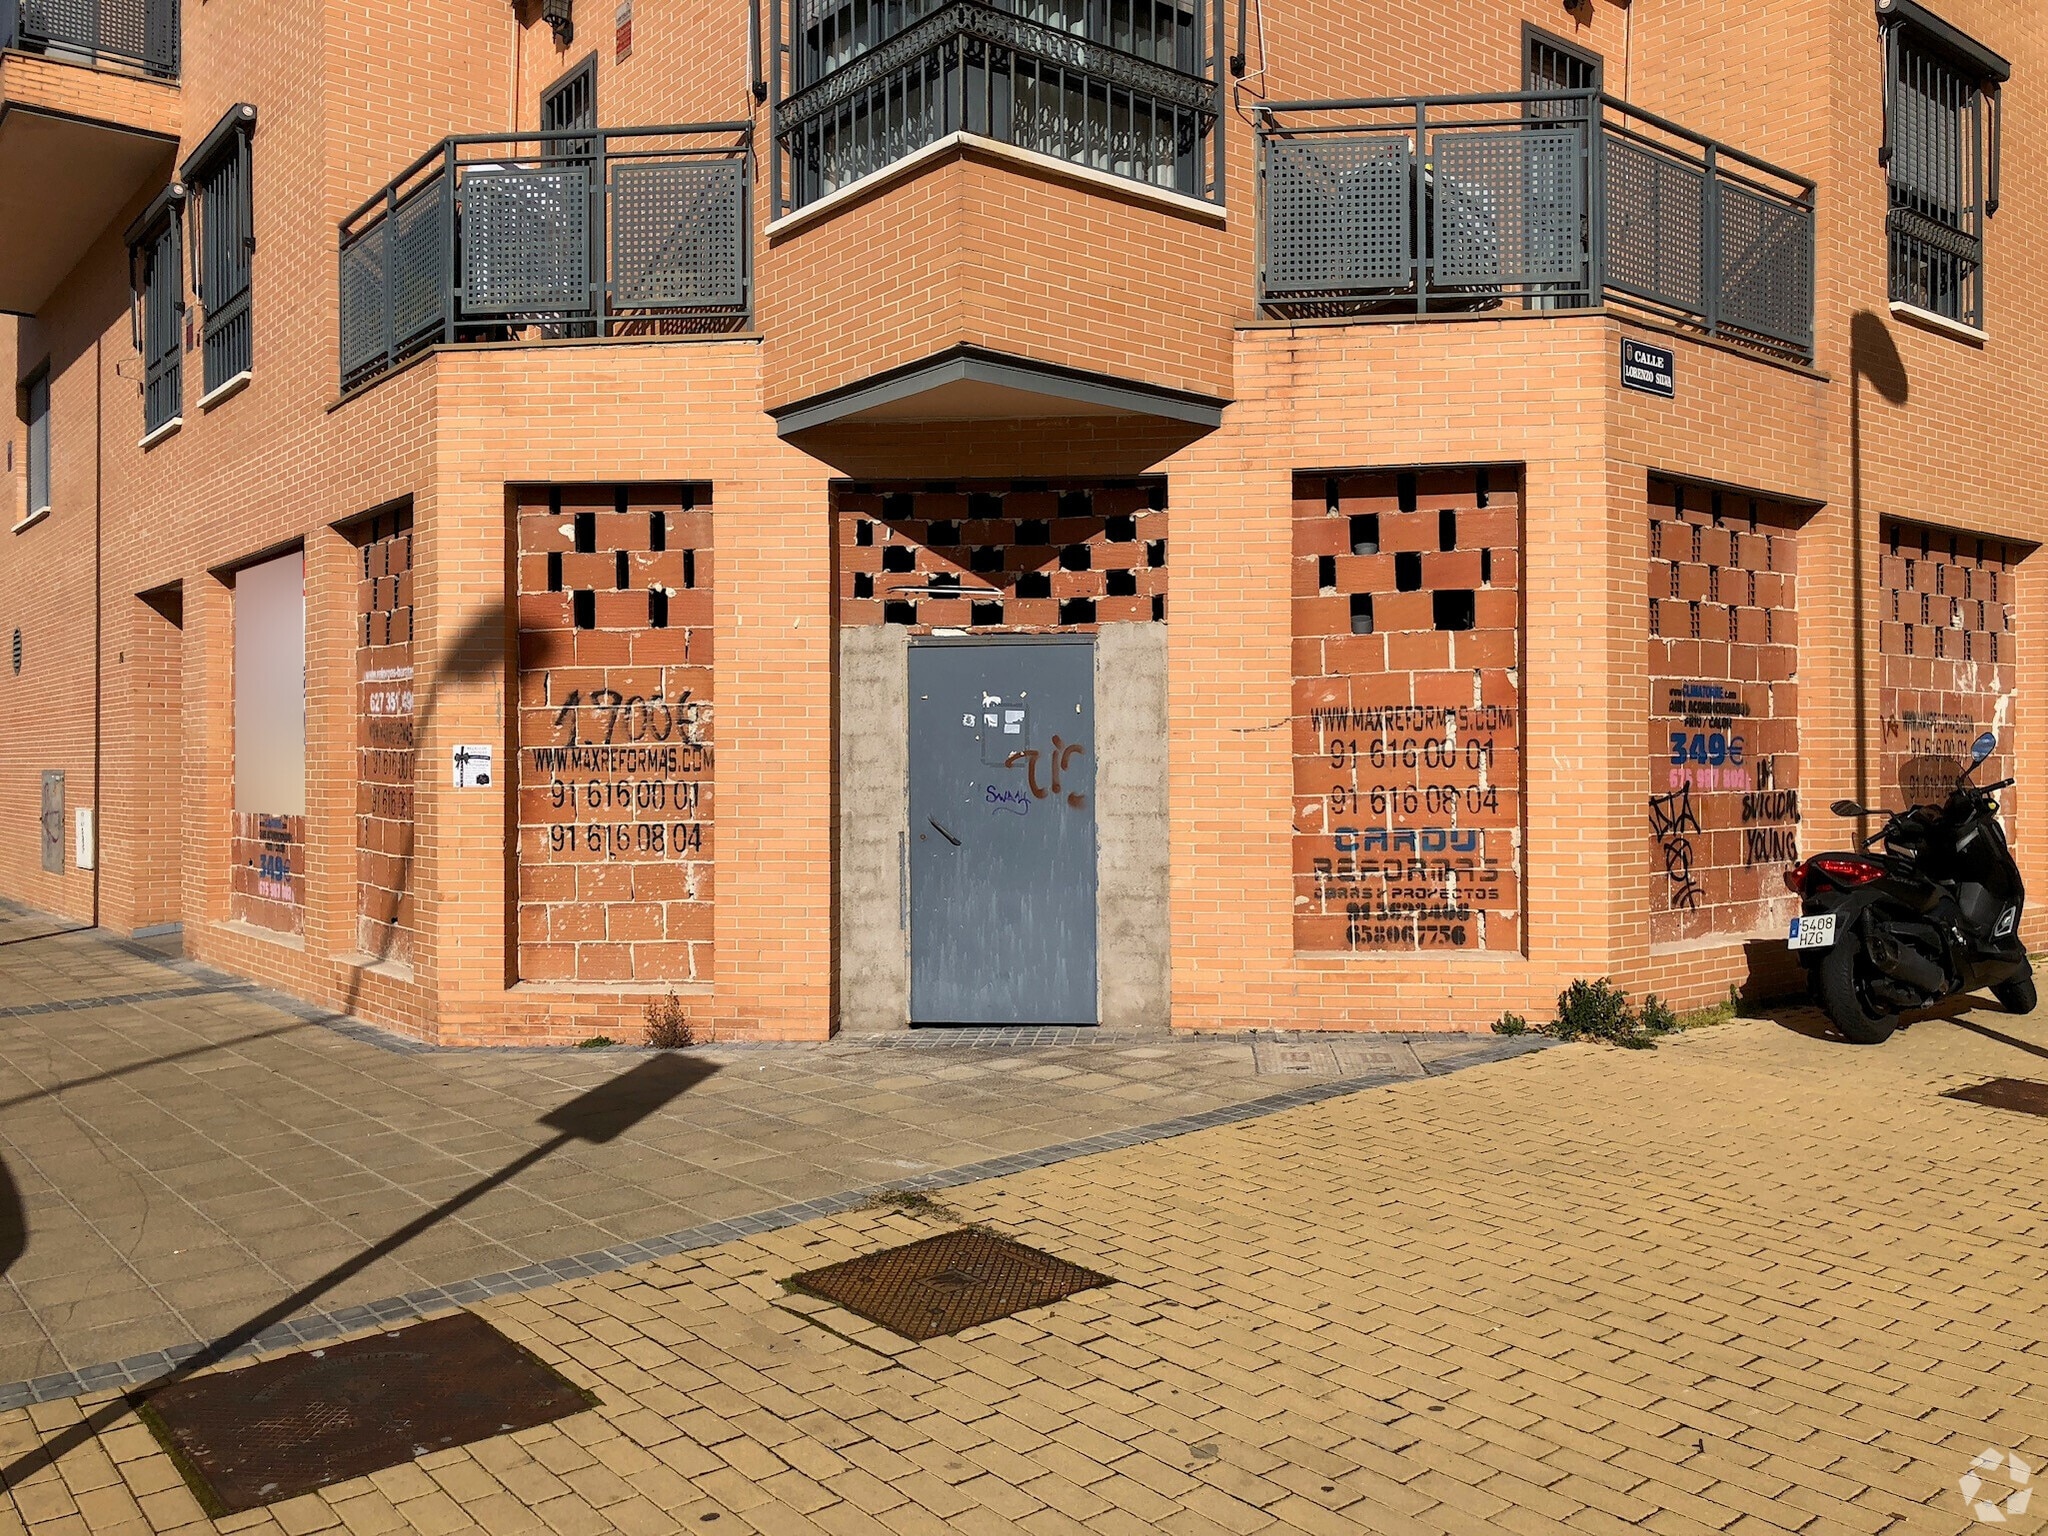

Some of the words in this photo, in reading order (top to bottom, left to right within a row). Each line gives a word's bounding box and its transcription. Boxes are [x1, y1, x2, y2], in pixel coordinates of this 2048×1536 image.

[1634, 350, 1664, 368] CALLE
[1625, 365, 1654, 383] LORENZO
[1331, 738, 1357, 768] 91
[1370, 738, 1418, 768] 616
[1424, 738, 1456, 768] 00
[1466, 738, 1493, 769] 01
[551, 780, 576, 808] 91
[587, 780, 631, 808] 616
[637, 780, 666, 809] 00
[674, 780, 699, 810] 01
[1331, 784, 1357, 814] 91
[1370, 784, 1418, 814] 616
[1466, 784, 1499, 814] 04
[551, 824, 576, 851] 91
[587, 824, 631, 851] 616
[638, 824, 666, 851] 08
[673, 823, 702, 852] 04
[1335, 827, 1476, 852] CARDU
[1312, 858, 1499, 883] REFORMAS
[1314, 888, 1372, 900] OBRAS
[1392, 888, 1500, 900] PROYECTOS
[1801, 917, 1833, 932] 5408
[1800, 931, 1823, 946] HZG
